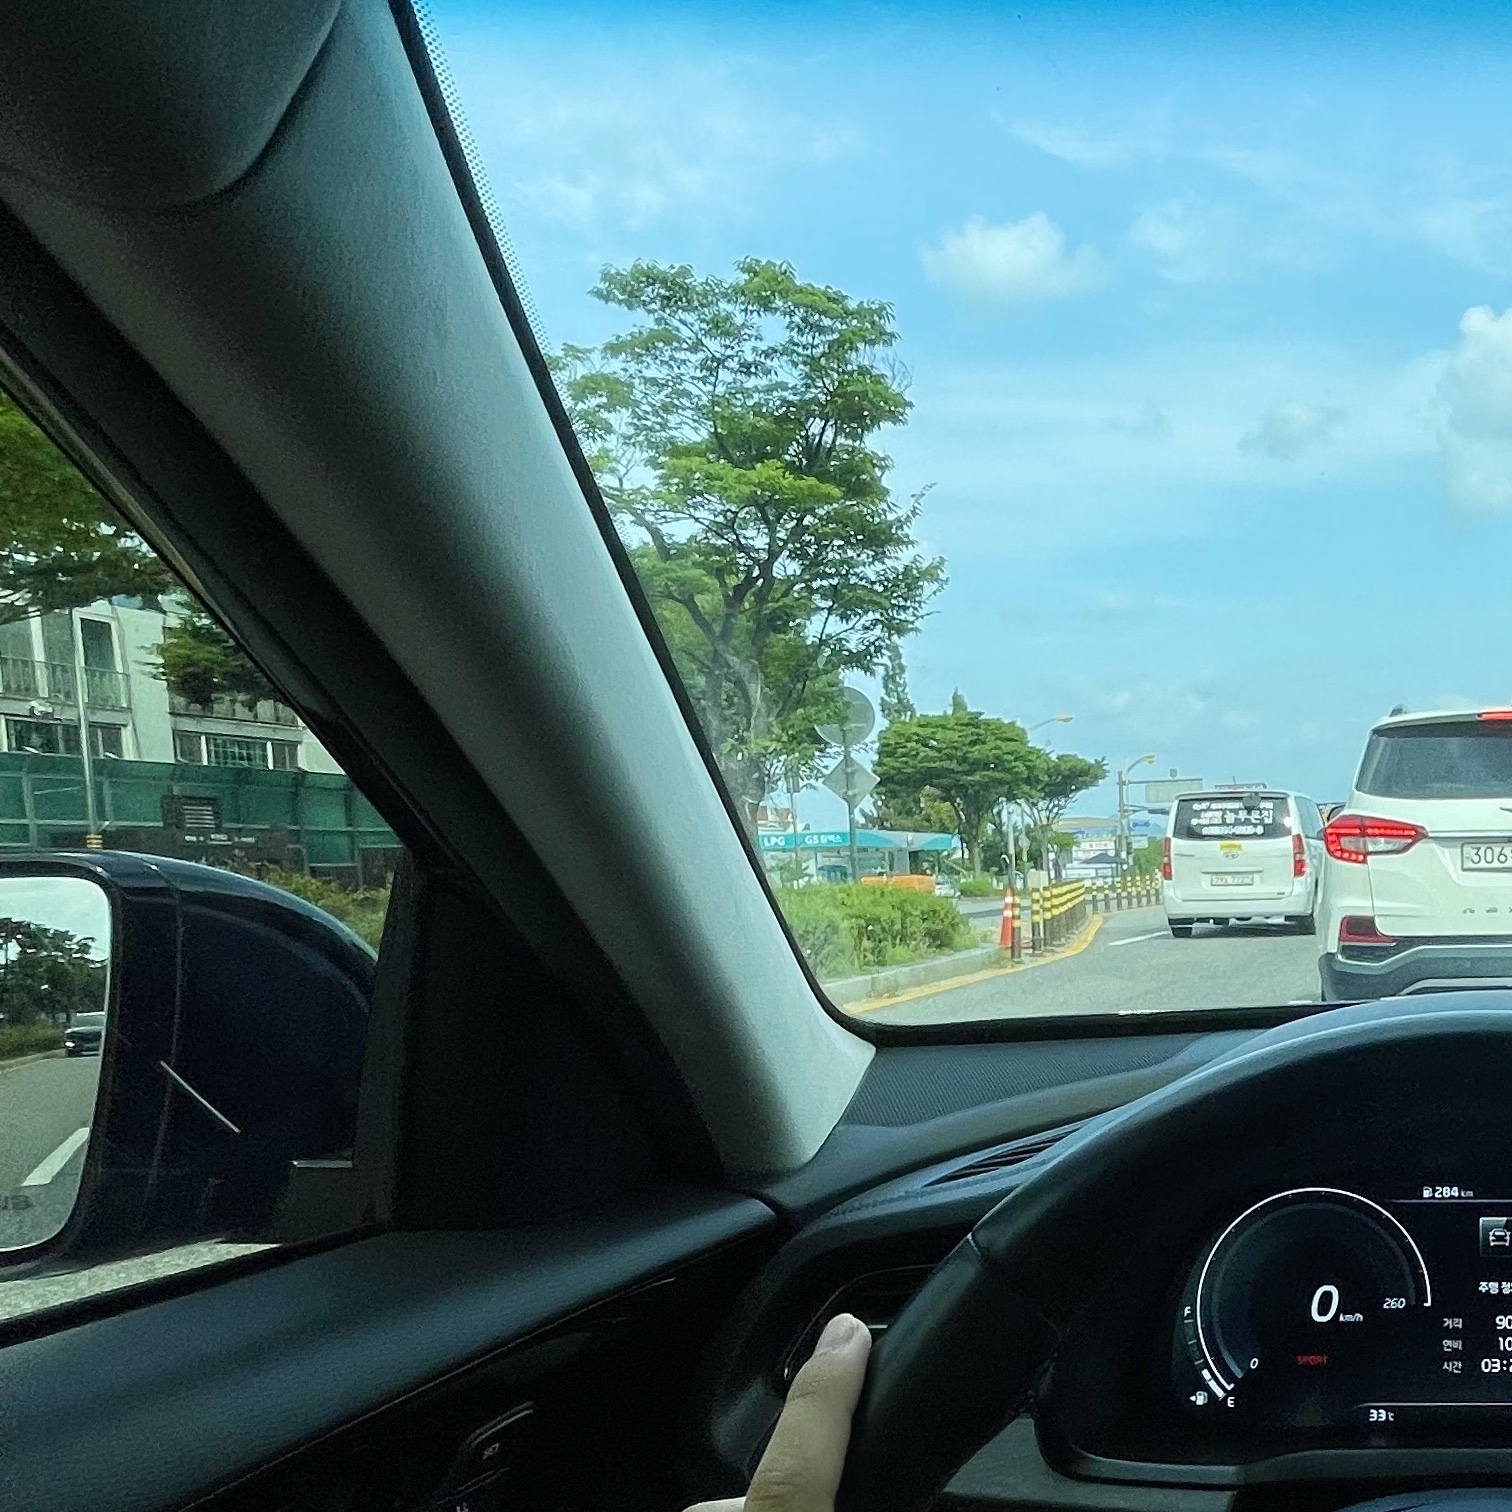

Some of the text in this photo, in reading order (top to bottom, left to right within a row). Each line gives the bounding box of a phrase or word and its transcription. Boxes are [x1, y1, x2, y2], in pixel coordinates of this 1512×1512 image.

[763, 836, 786, 847] LPG
[1382, 1297, 1406, 1309] 260
[1442, 1317, 1463, 1330] 거리
[1442, 1360, 1463, 1374] 시간
